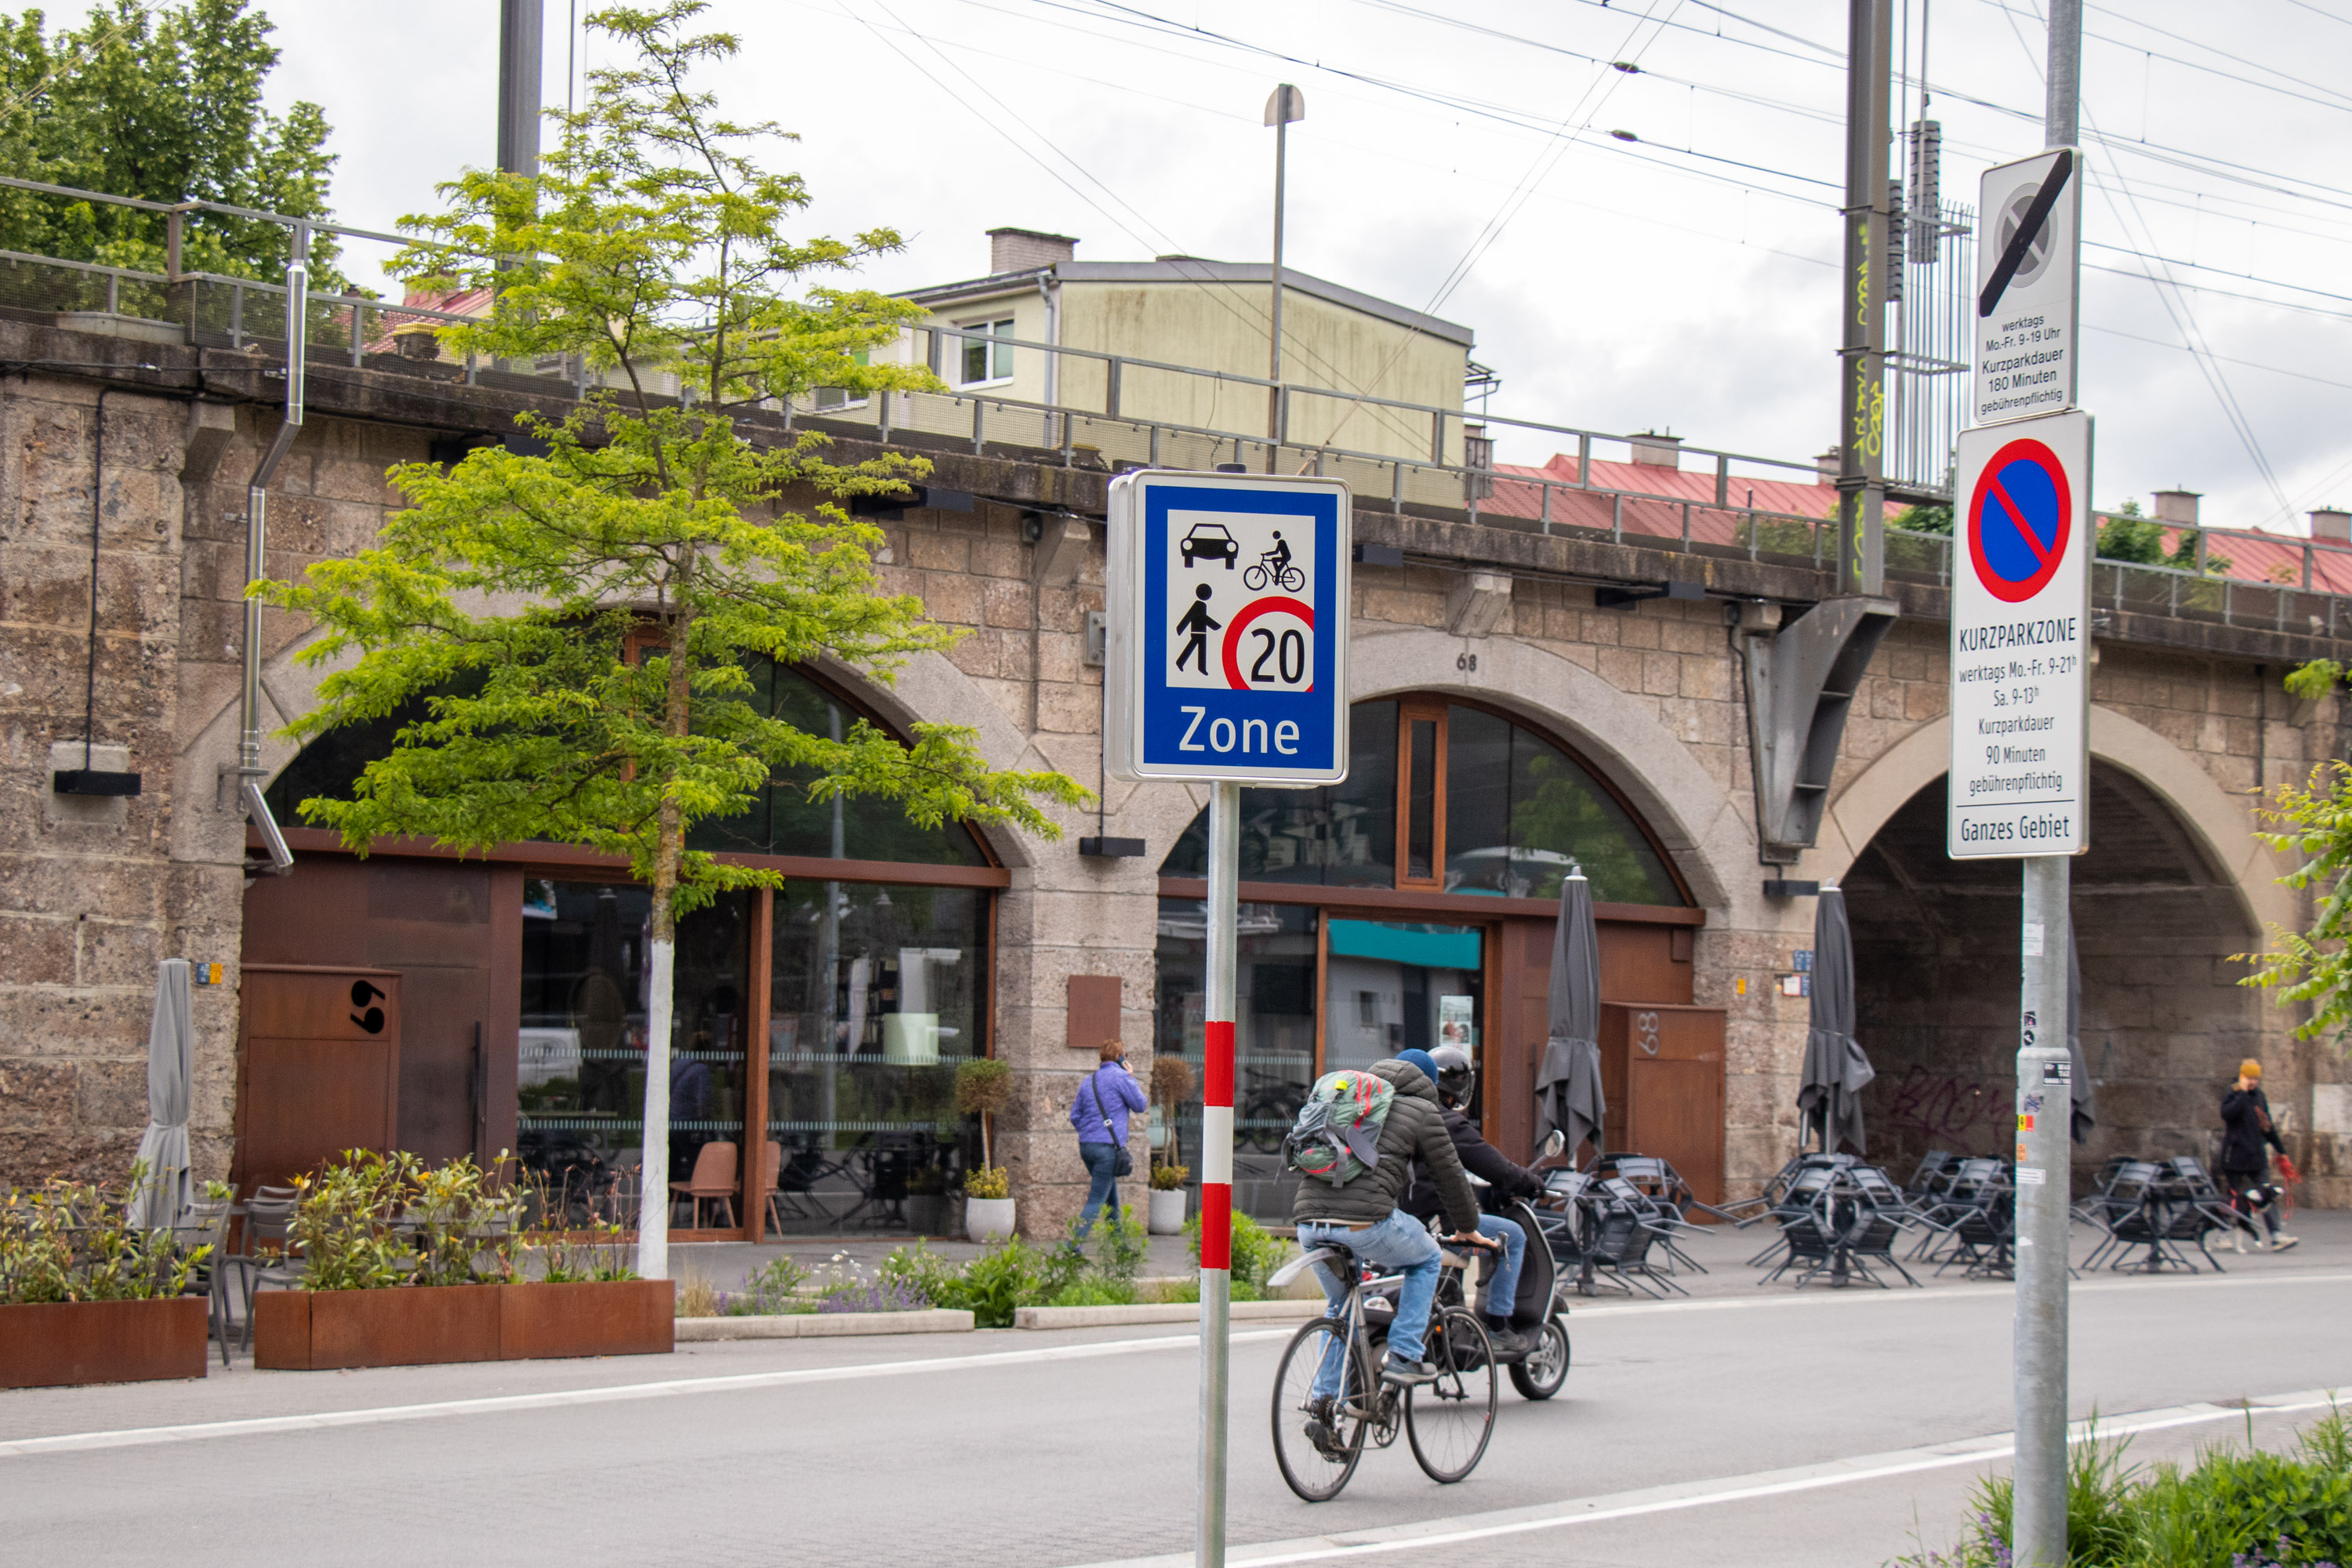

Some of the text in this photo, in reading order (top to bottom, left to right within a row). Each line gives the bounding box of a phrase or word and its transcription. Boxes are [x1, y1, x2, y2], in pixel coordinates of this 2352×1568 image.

[2002, 315, 2044, 332] werktags
[1986, 336, 2016, 352] Mo.-Fr.
[2044, 328, 2060, 340] Uhr
[1982, 349, 2063, 375] Kurzparkdauer
[1989, 370, 2056, 393] 180 Minuten
[1981, 389, 2063, 415] gebührenpflichtig
[1959, 618, 2076, 652] KURZPARKZONE
[1251, 628, 1305, 684] 20
[1457, 652, 1477, 672] 68
[1959, 665, 2005, 683] werktags
[2009, 659, 2045, 678] Mo.-Fr.
[1994, 690, 2009, 706] Sa.
[1179, 706, 1300, 755] Zone
[1979, 715, 2054, 736] Kurzparkdauer
[1986, 746, 2045, 764] 90 Minuten
[1969, 771, 2062, 797] gebührenpflichtig
[1962, 813, 2069, 841] Ganzes Gebiet
